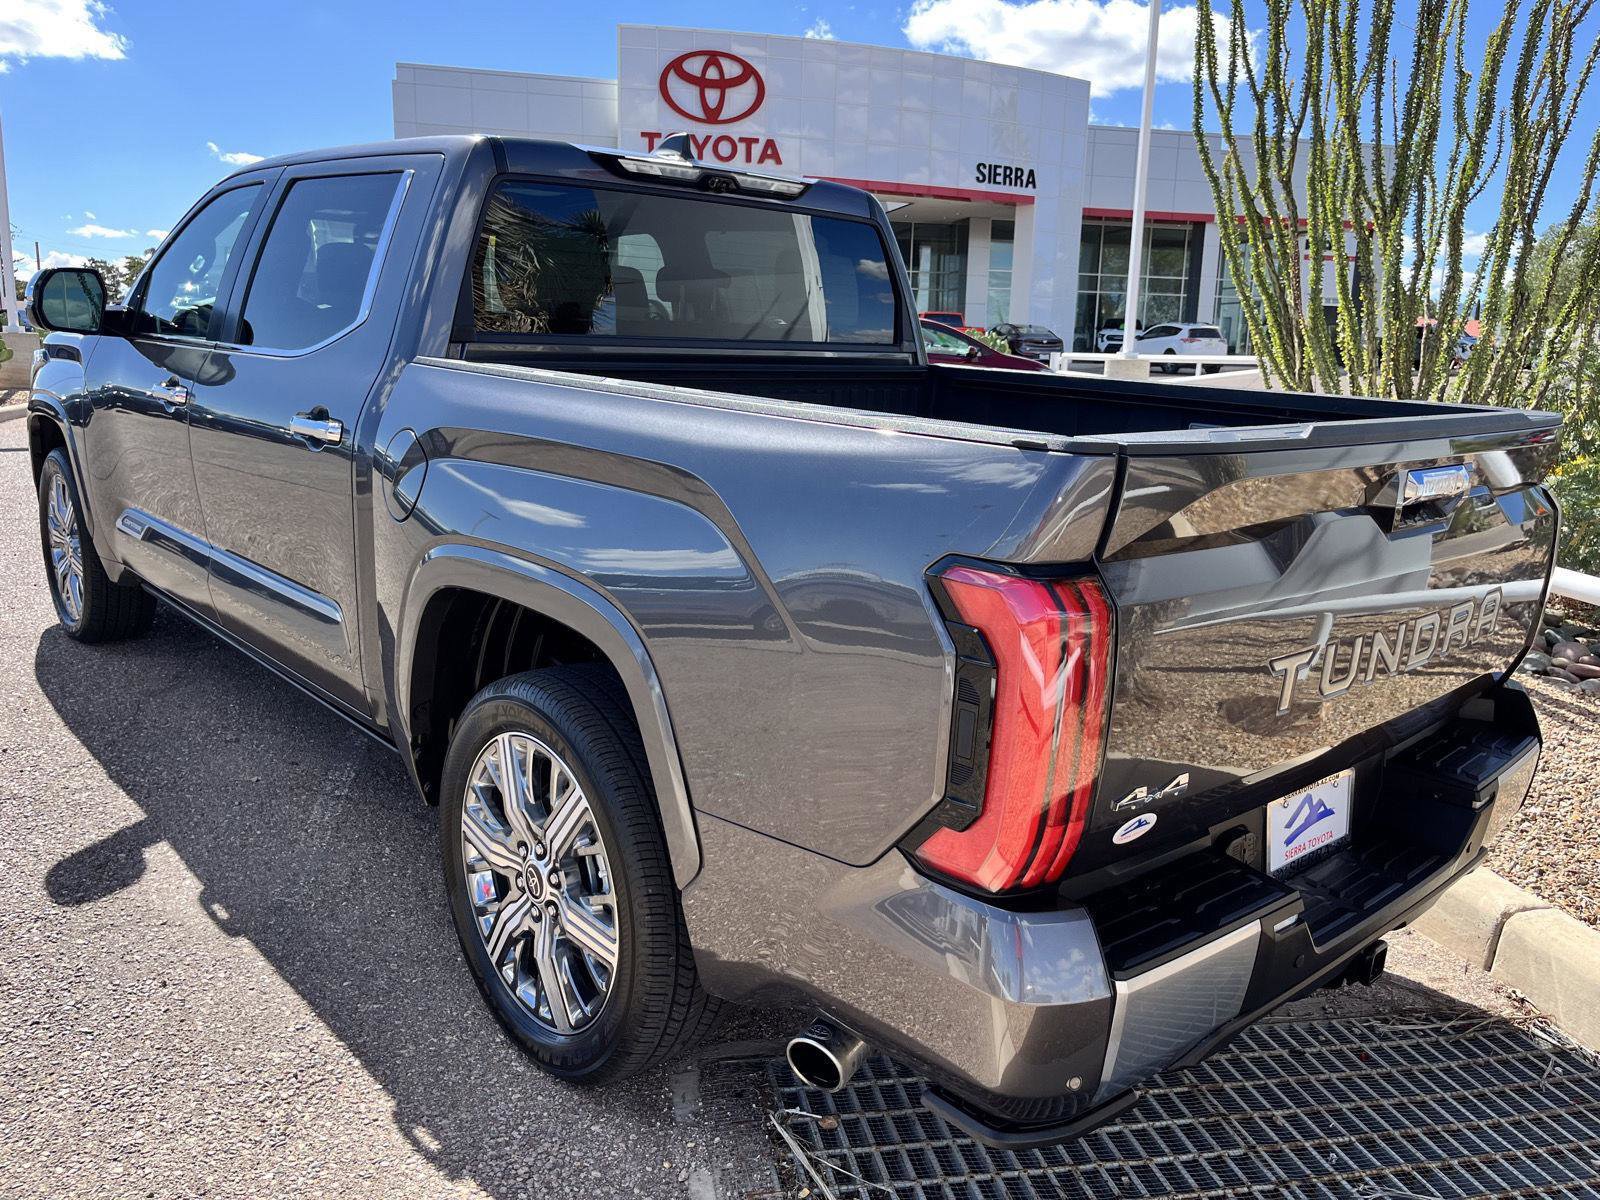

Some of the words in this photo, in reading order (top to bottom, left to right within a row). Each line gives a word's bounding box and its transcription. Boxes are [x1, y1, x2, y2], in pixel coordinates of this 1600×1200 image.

[640, 132, 783, 165] TYOTA
[975, 162, 1037, 189] SIERRA
[1268, 586, 1502, 716] TUNDRA
[1284, 843, 1307, 861] SIERRA
[1308, 830, 1334, 848] TOYOTA
